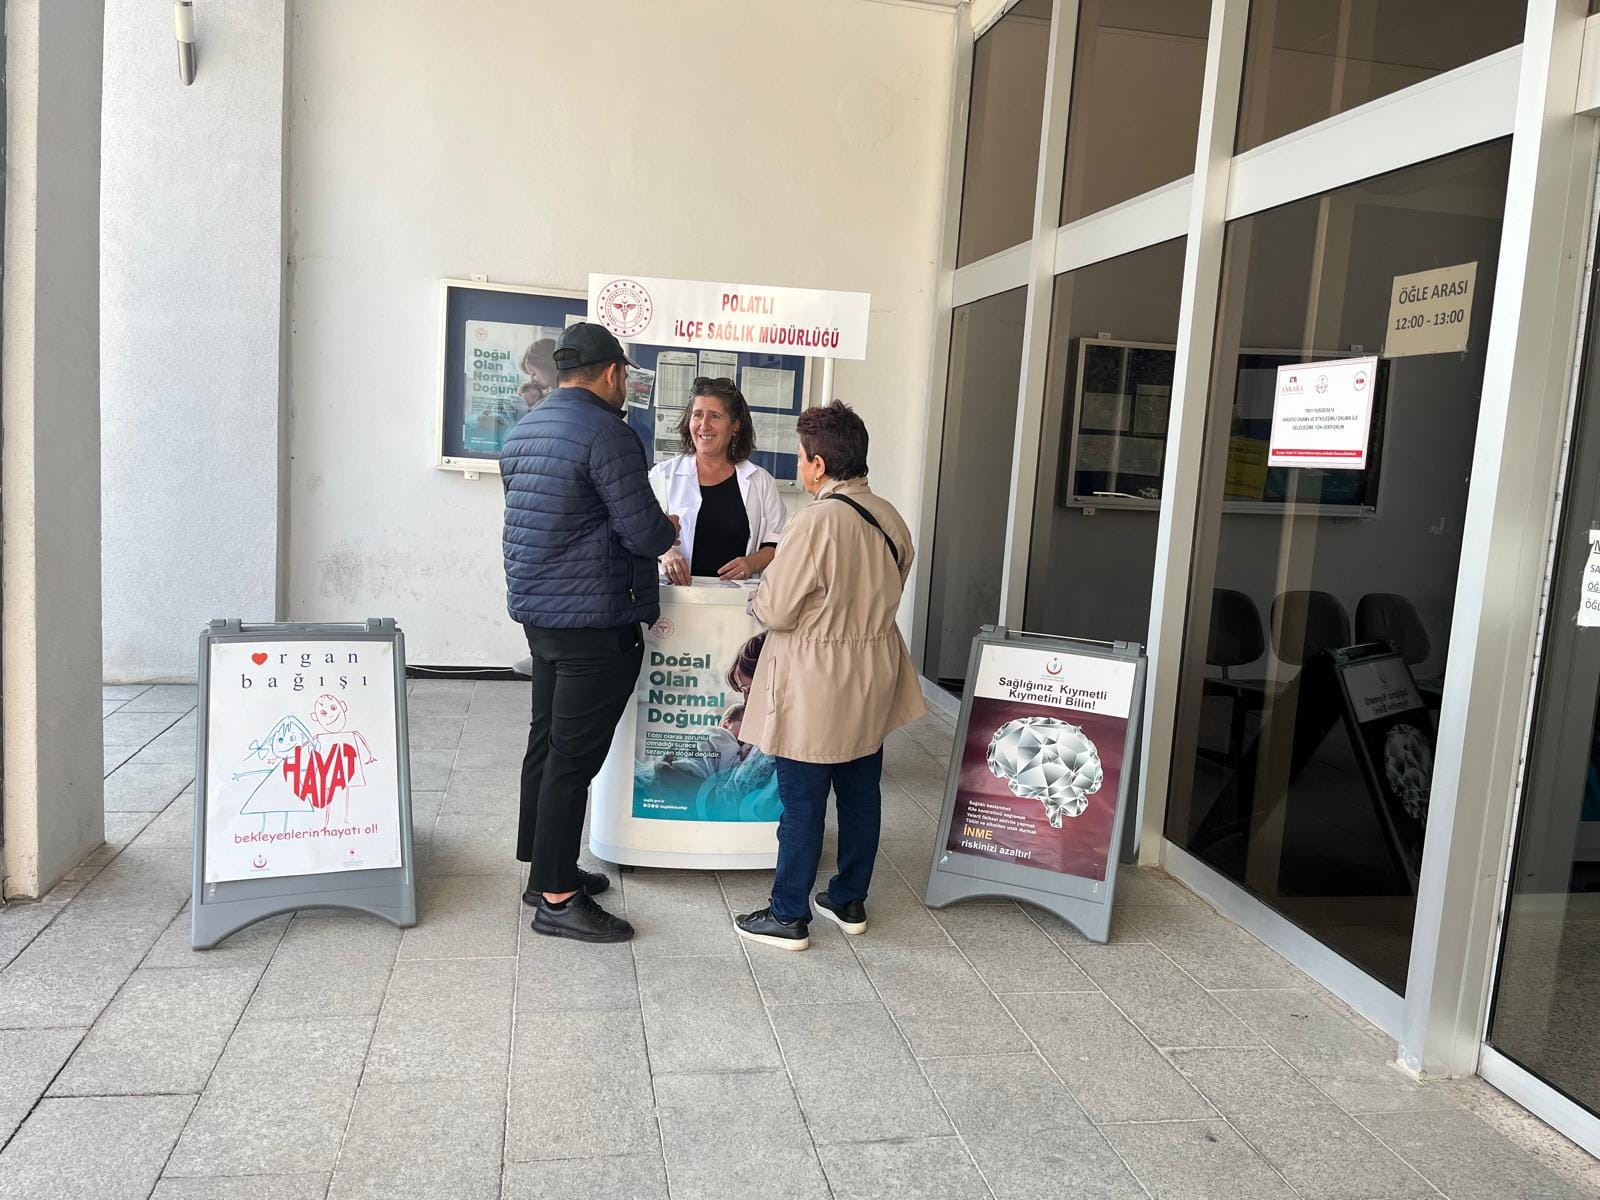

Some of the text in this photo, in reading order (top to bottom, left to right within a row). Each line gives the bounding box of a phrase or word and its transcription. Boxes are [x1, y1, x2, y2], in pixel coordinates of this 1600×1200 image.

[1398, 280, 1468, 304] ÖĞLE ARASI
[722, 294, 774, 314] POLATLI
[1395, 314, 1424, 330] 12:00
[1433, 308, 1464, 326] 13:00
[708, 320, 754, 343] SAĞLIK
[759, 324, 840, 348] MÜDÜRLÜĞÜ
[474, 348, 510, 361] Doğal
[474, 360, 503, 371] Olan
[473, 370, 520, 384] Normal
[650, 652, 710, 672] Doğal
[241, 673, 367, 691] bağışı
[650, 671, 698, 687] Olan
[998, 676, 1053, 692] Sağlığınız
[1060, 684, 1108, 700] Kıymetli
[649, 689, 725, 707] Normal
[1008, 689, 1096, 710] Kıymetini Bilin!
[648, 708, 722, 728] Doğum
[283, 742, 357, 809] HAYAT
[234, 824, 378, 844] bekleyenlerin hayatı ol!
[963, 824, 993, 840] İNME
[961, 840, 1032, 859] riskinizi azaltır!
